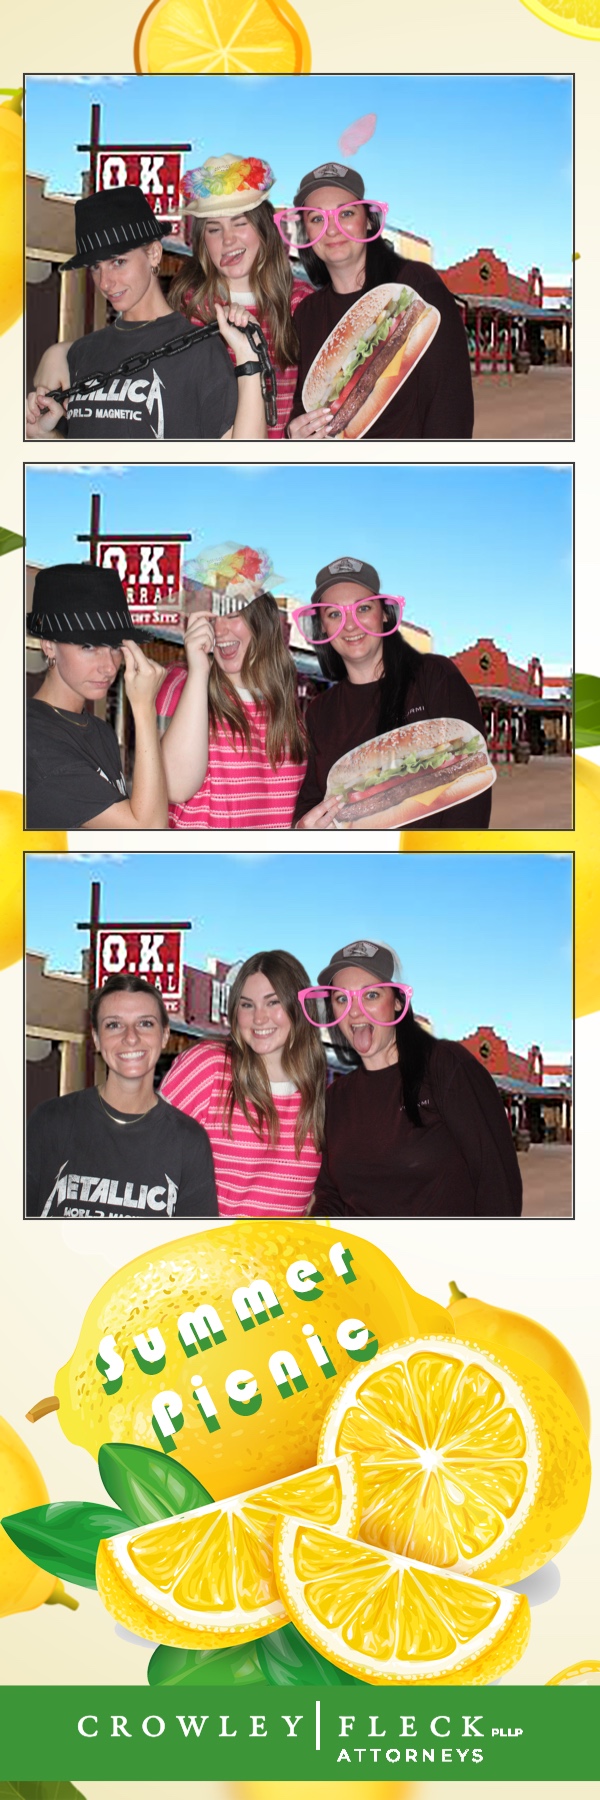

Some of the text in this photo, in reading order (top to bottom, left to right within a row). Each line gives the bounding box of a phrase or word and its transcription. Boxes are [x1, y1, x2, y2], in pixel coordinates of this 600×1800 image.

[95, 408, 142, 421] MAGNETIC
[102, 546, 175, 586] O.K.
[126, 587, 177, 604] RRAL
[102, 934, 175, 974] O.K.
